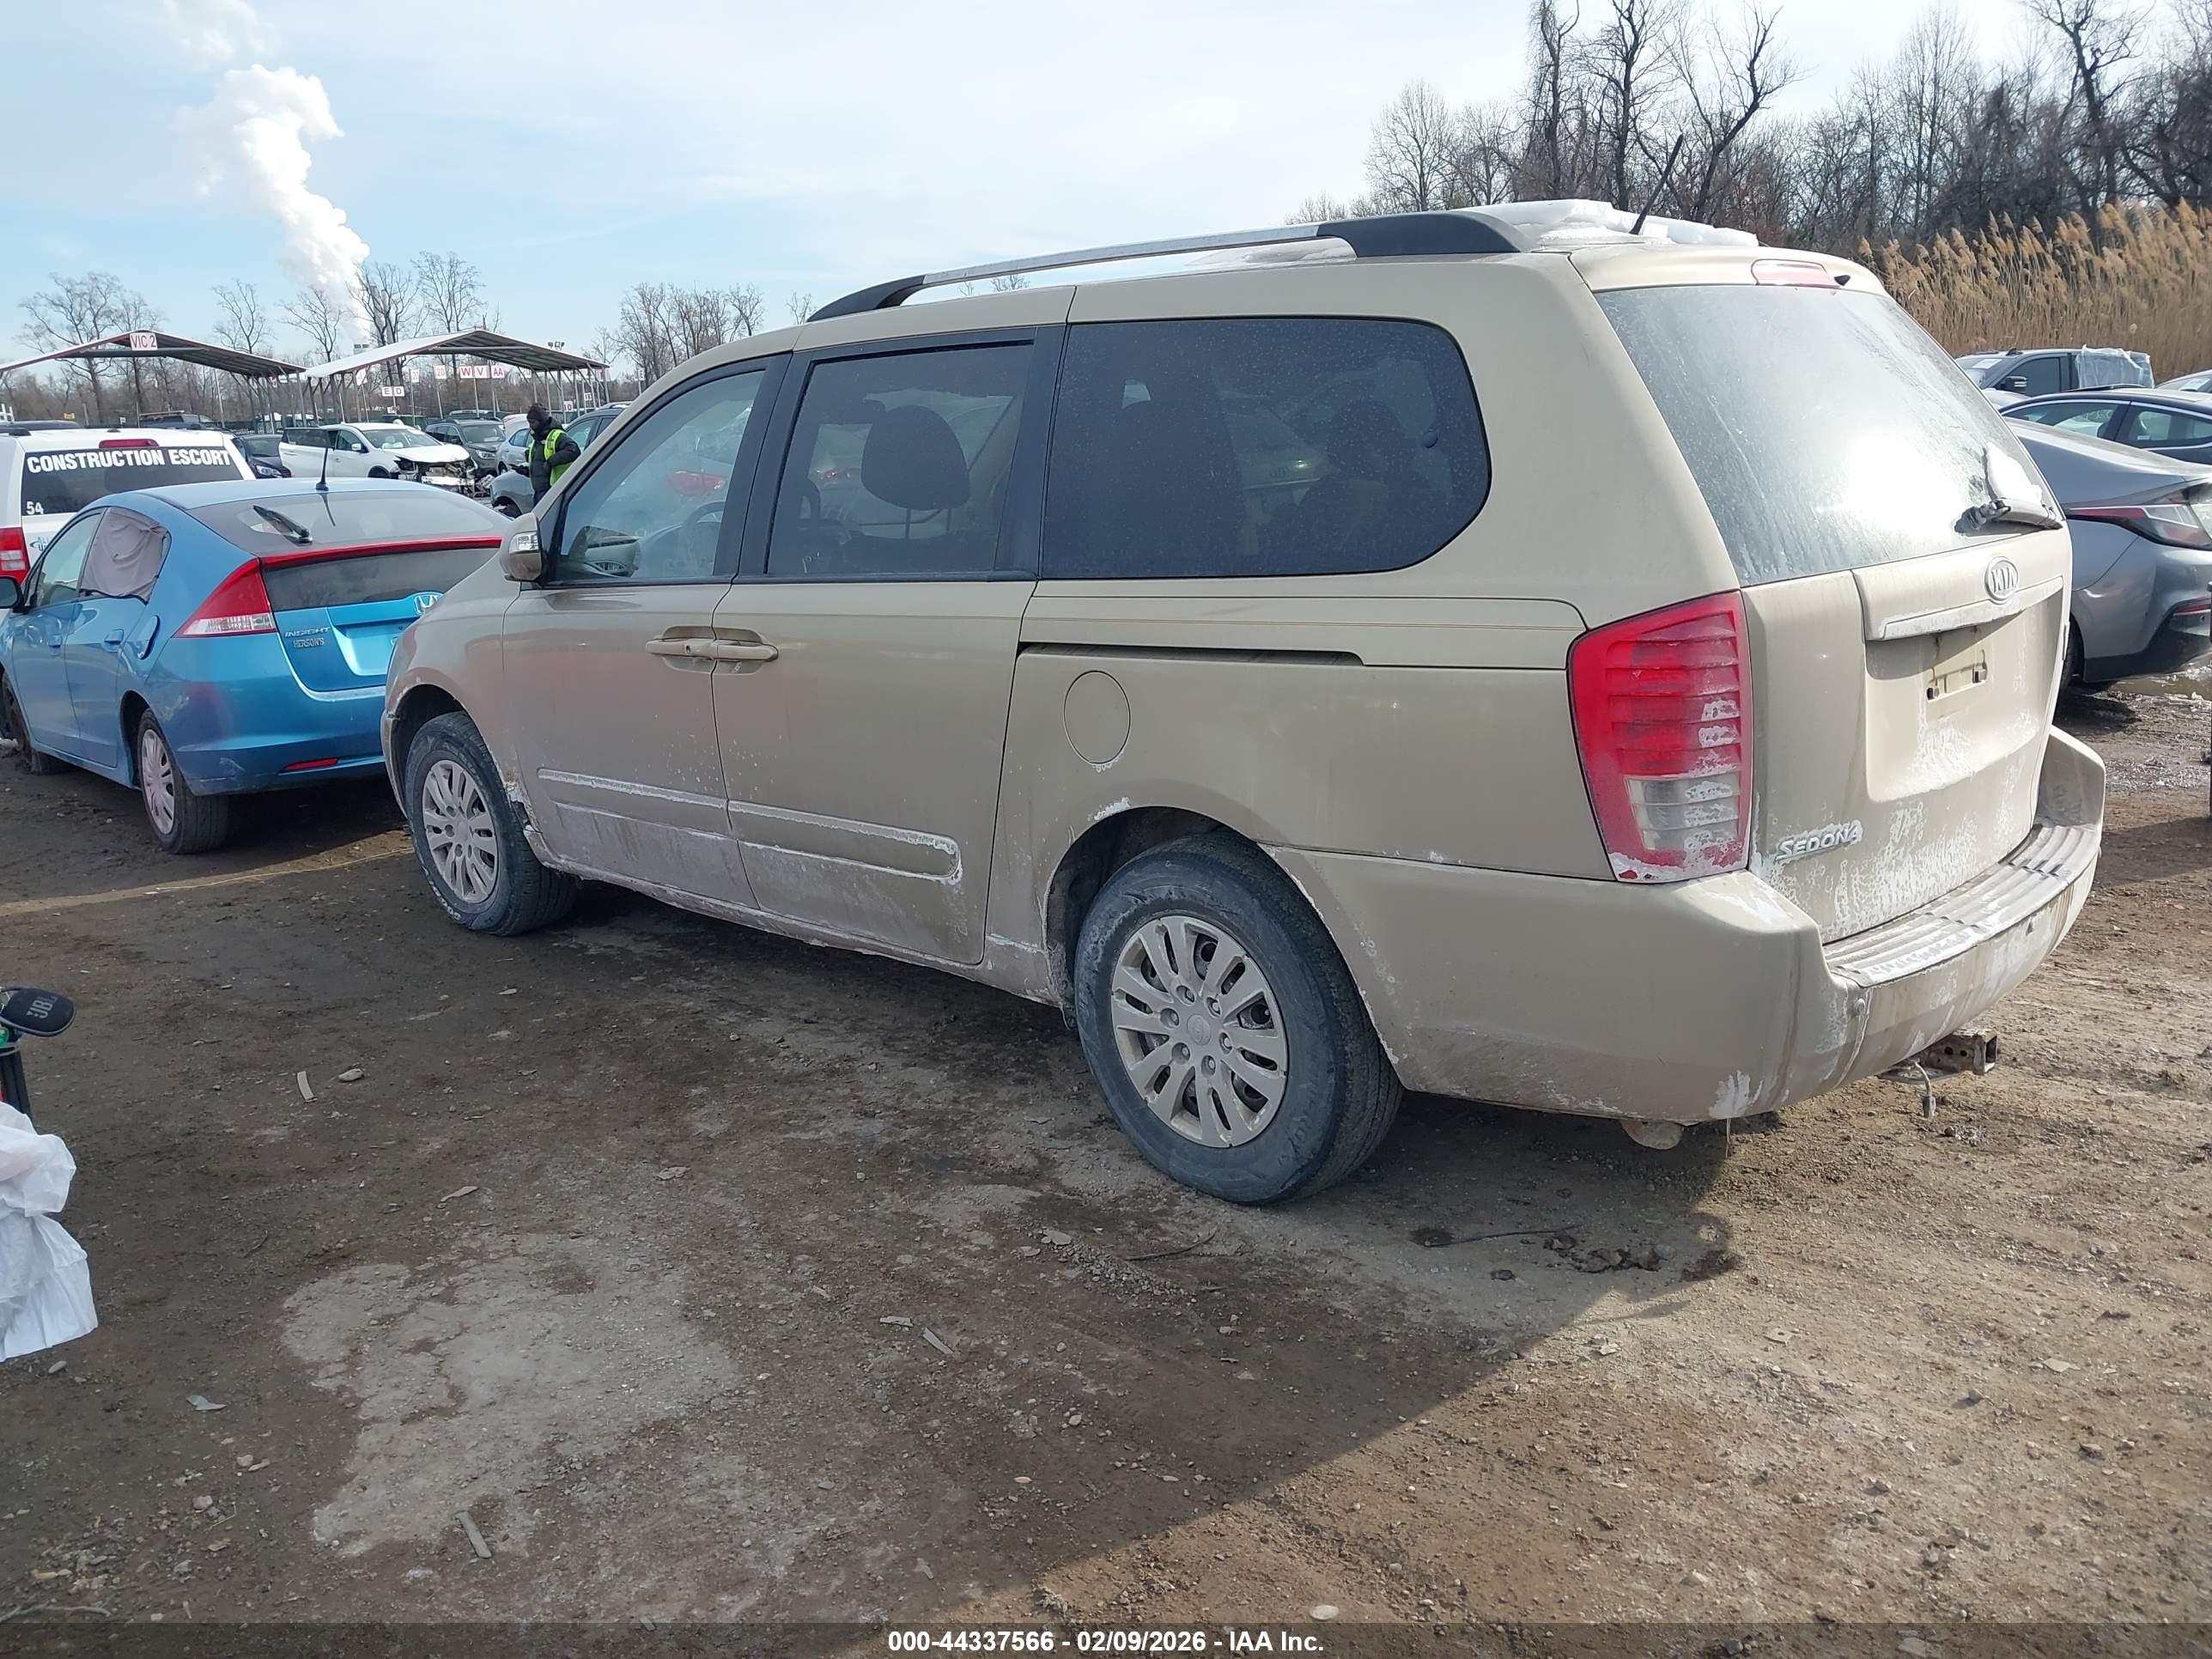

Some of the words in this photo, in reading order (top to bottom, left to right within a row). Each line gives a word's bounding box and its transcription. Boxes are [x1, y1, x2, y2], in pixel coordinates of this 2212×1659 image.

[131, 335, 148, 349] VIC
[149, 334, 156, 348] 2
[493, 368, 503, 376] AA
[27, 449, 166, 473] CONSTRUCTION
[168, 449, 232, 465] ESCORT
[26, 501, 44, 515] 54
[284, 627, 331, 637] INSIGHT
[1775, 822, 1863, 860] SEDONA
[29, 995, 58, 1019] JBL
